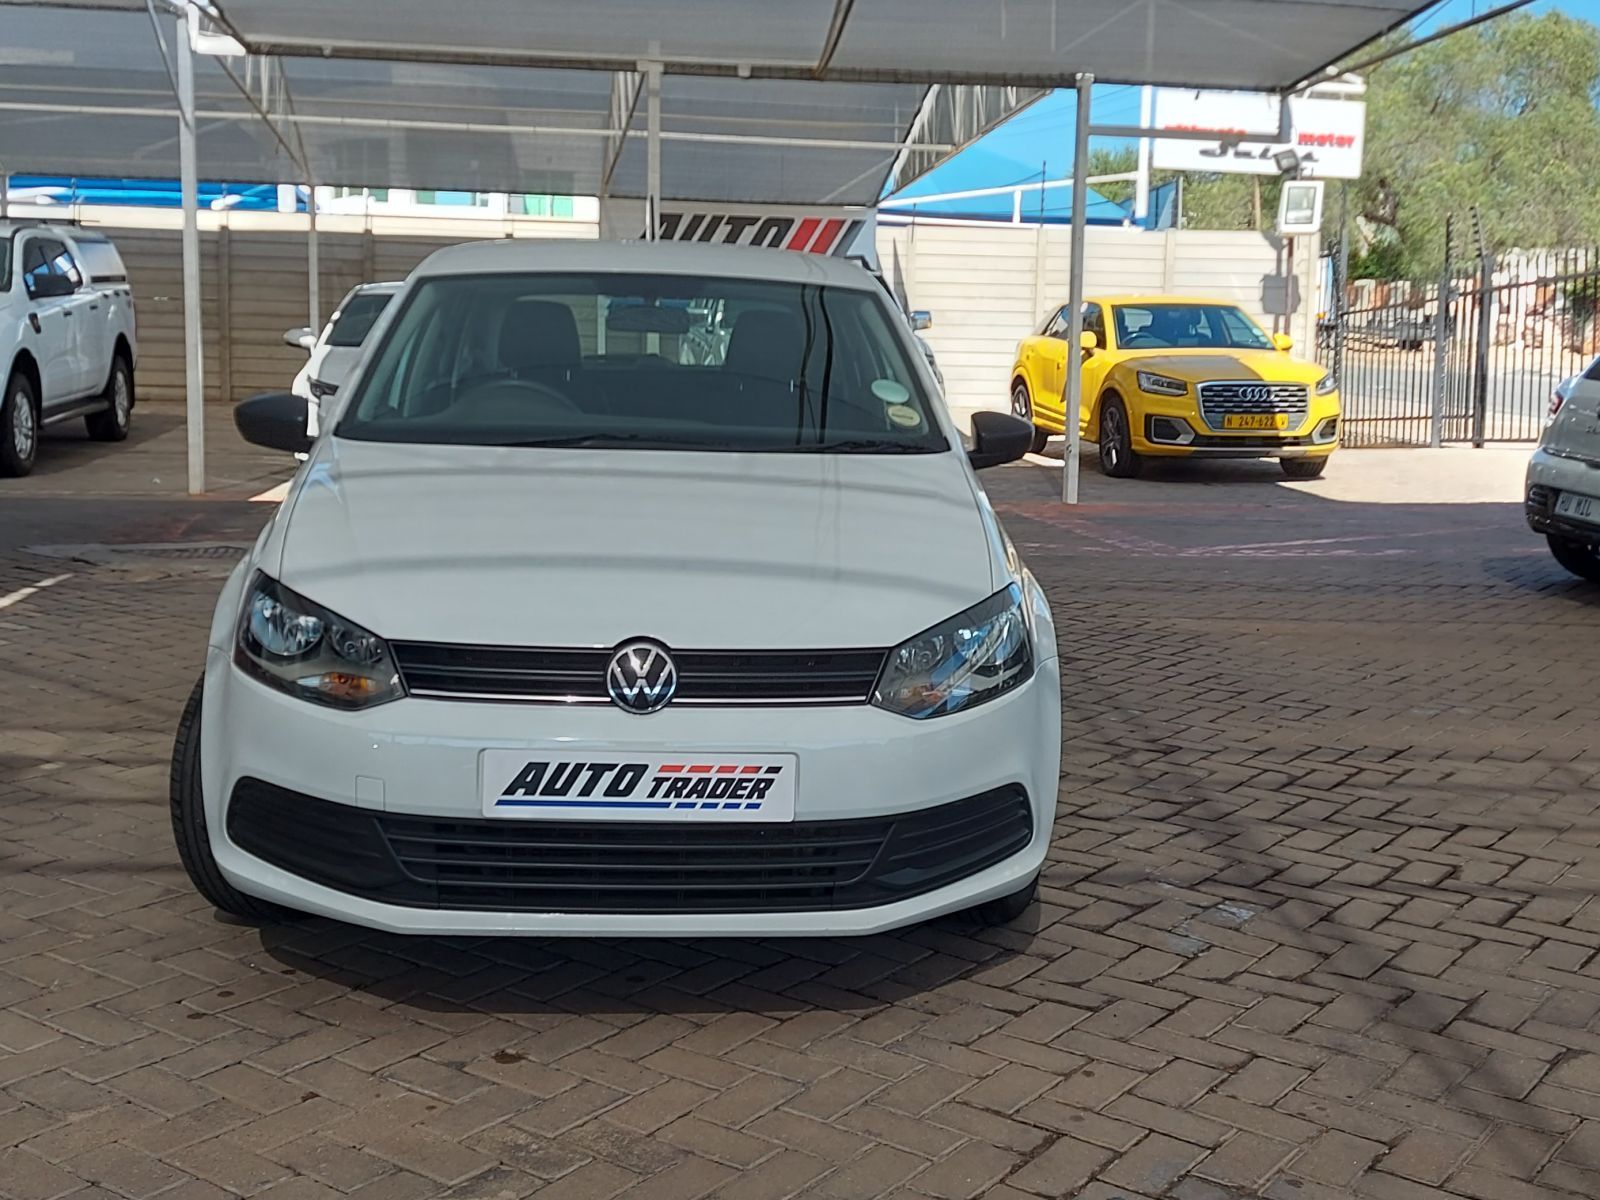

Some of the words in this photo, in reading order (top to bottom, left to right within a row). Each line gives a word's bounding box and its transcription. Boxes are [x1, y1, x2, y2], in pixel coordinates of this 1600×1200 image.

[1298, 131, 1355, 148] motor
[501, 761, 650, 797] AUTO
[646, 776, 775, 800] TRADER
